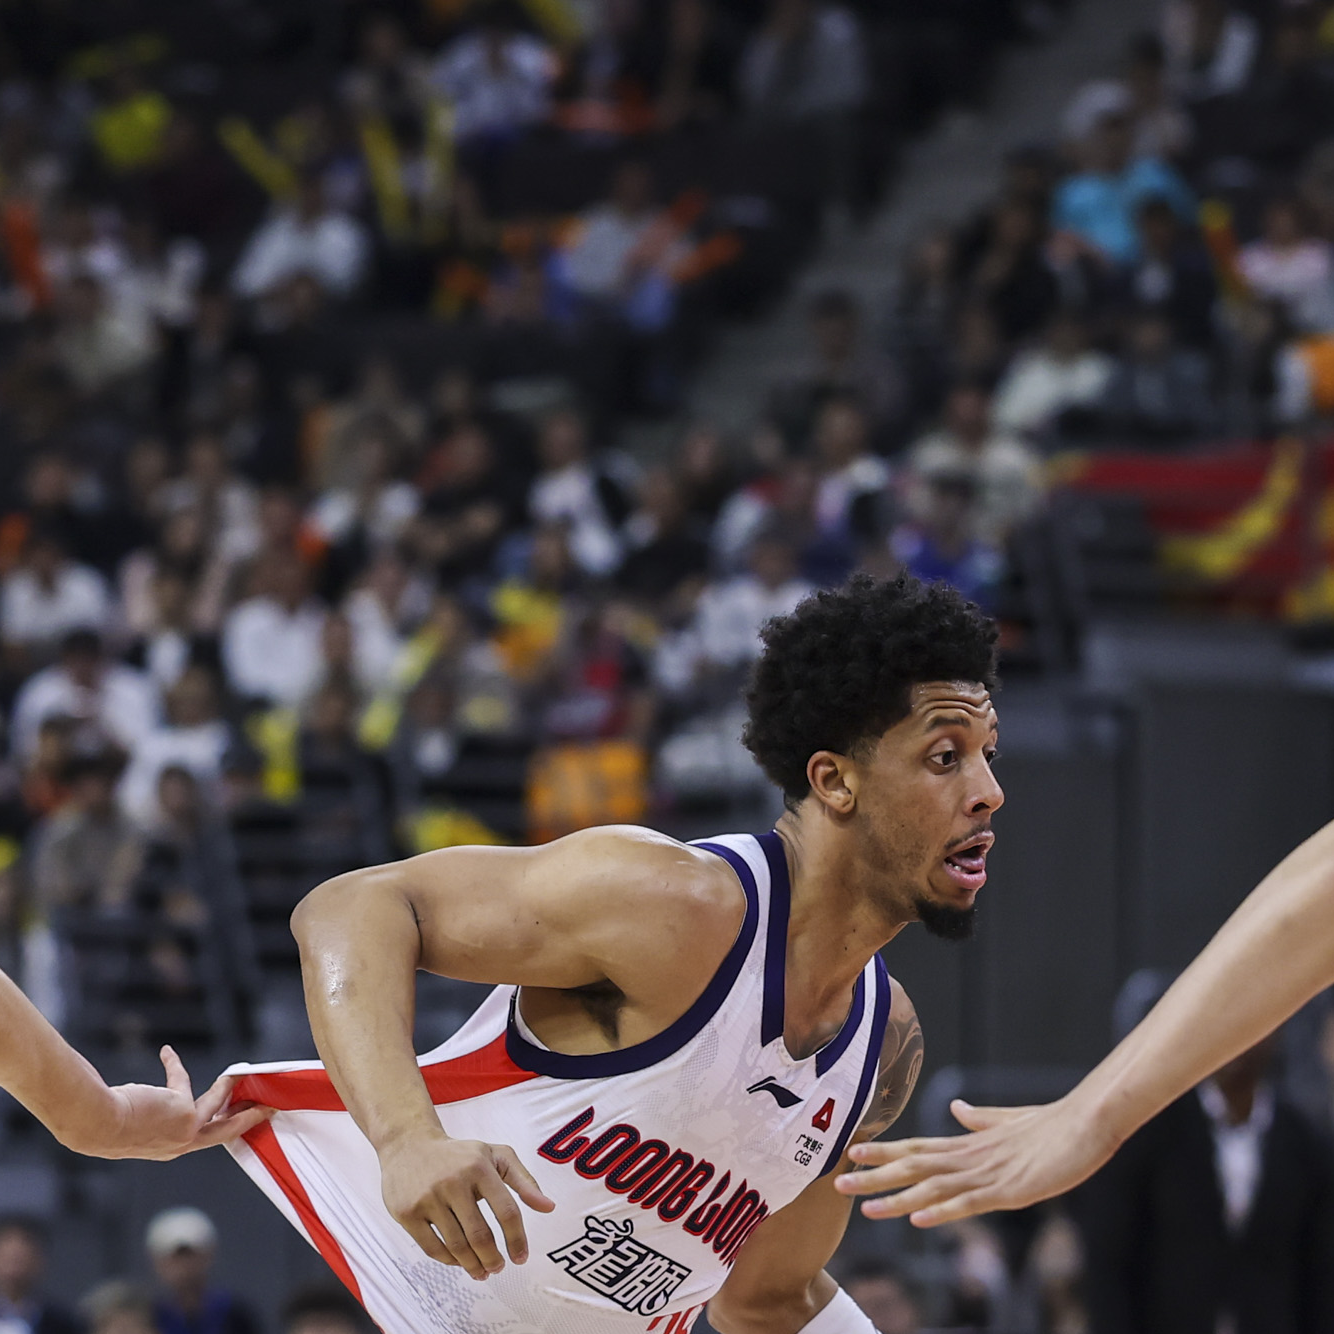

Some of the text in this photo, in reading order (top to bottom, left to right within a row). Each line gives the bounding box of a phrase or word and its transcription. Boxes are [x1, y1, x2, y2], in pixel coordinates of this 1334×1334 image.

[537, 1106, 771, 1271] LOONG LION
[794, 1150, 812, 1167] CGB
